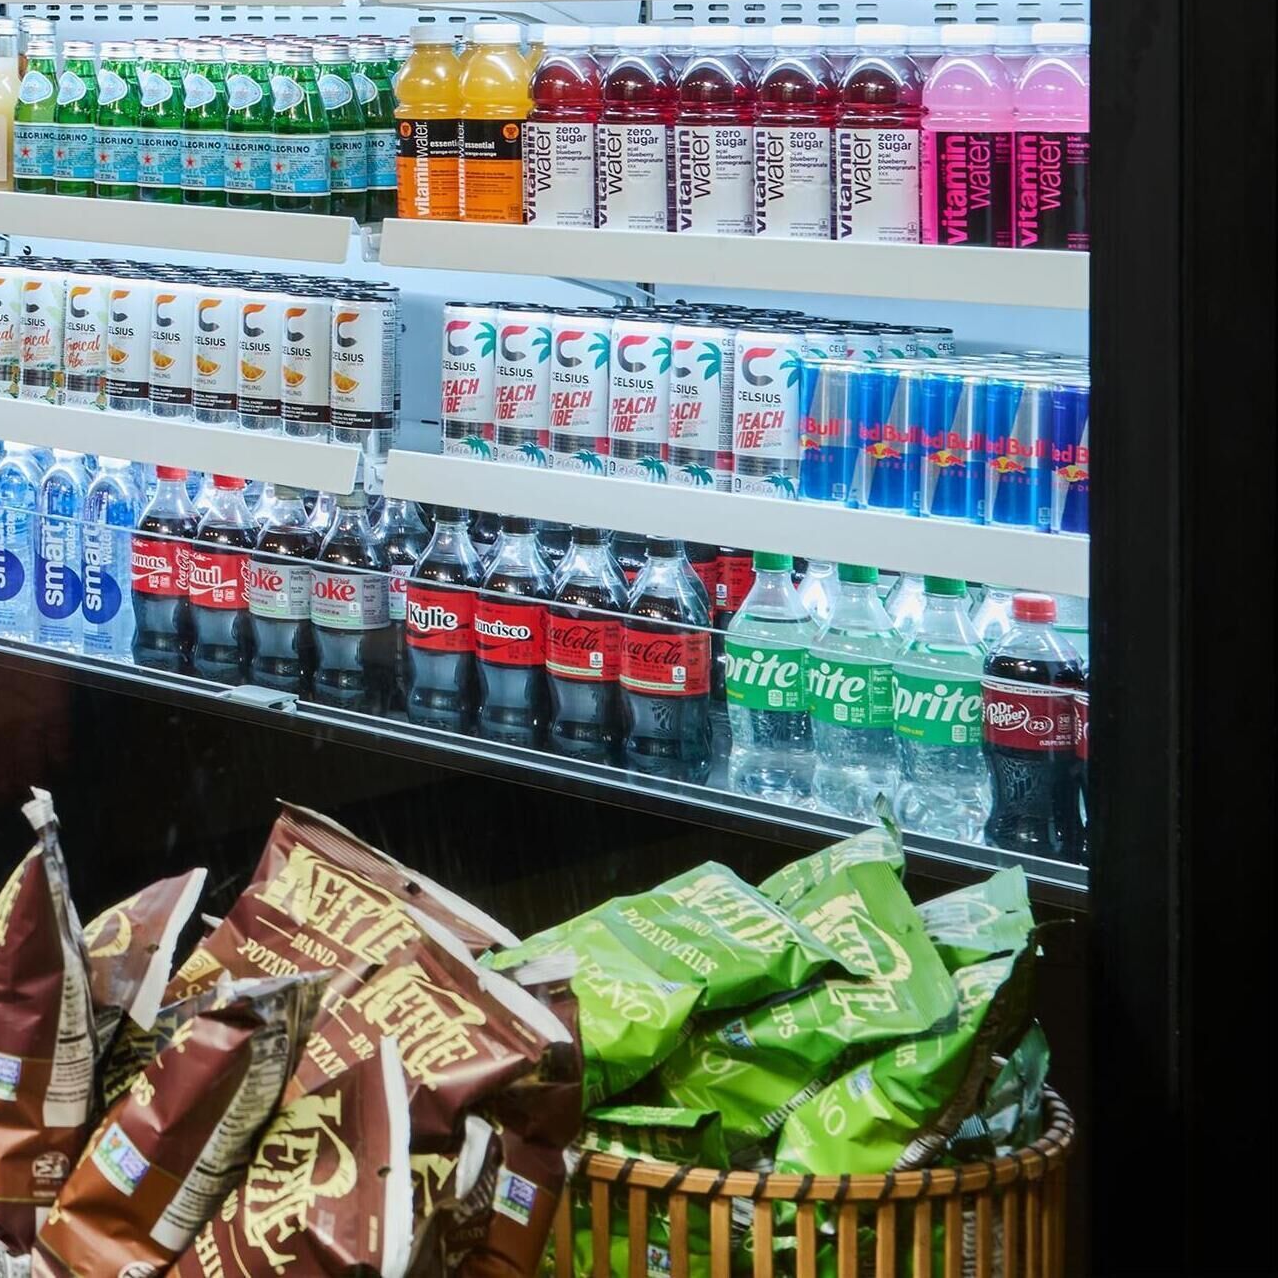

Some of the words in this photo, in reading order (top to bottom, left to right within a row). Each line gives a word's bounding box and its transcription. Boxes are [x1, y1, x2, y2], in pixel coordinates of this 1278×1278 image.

[556, 135, 587, 143] sugar
[627, 137, 659, 145] sugar
[716, 138, 747, 148] sugar
[790, 140, 824, 149] sugar
[878, 133, 905, 141] zero
[878, 142, 912, 151] sugar
[527, 126, 536, 222] vitamin
[536, 127, 551, 191] water
[599, 128, 607, 226] vitamin
[608, 128, 622, 195] water
[692, 131, 711, 198] water
[767, 132, 785, 200] water
[855, 133, 872, 204] water
[968, 136, 991, 210] water
[1040, 136, 1061, 211] water
[678, 131, 692, 230] vitamin
[754, 131, 767, 234] vitamin
[838, 133, 852, 239] vitamin
[941, 136, 968, 245] vitamin
[1019, 135, 1038, 246] vitamin
[614, 376, 654, 390] CELSIUS
[738, 390, 781, 404] CELSIUS
[612, 397, 658, 414] PEACH
[738, 410, 784, 429] PEACH
[735, 431, 764, 450] VIBE
[806, 418, 840, 436] Bull
[884, 425, 918, 443] Bull
[946, 433, 982, 452] Bull
[1007, 439, 1044, 458] Bull
[66, 523, 77, 560] water
[101, 526, 112, 565] water
[43, 516, 64, 606] smart
[84, 520, 102, 611] smart
[133, 556, 168, 570] omas
[408, 602, 458, 631] Kylie
[727, 651, 797, 688] prite
[809, 663, 865, 703] rite
[987, 710, 1027, 726] Pepper
[996, 703, 1014, 714] Dr
[1032, 720, 1045, 730] 23
[618, 906, 677, 951] POTATO
[677, 944, 718, 975] CHIPS
